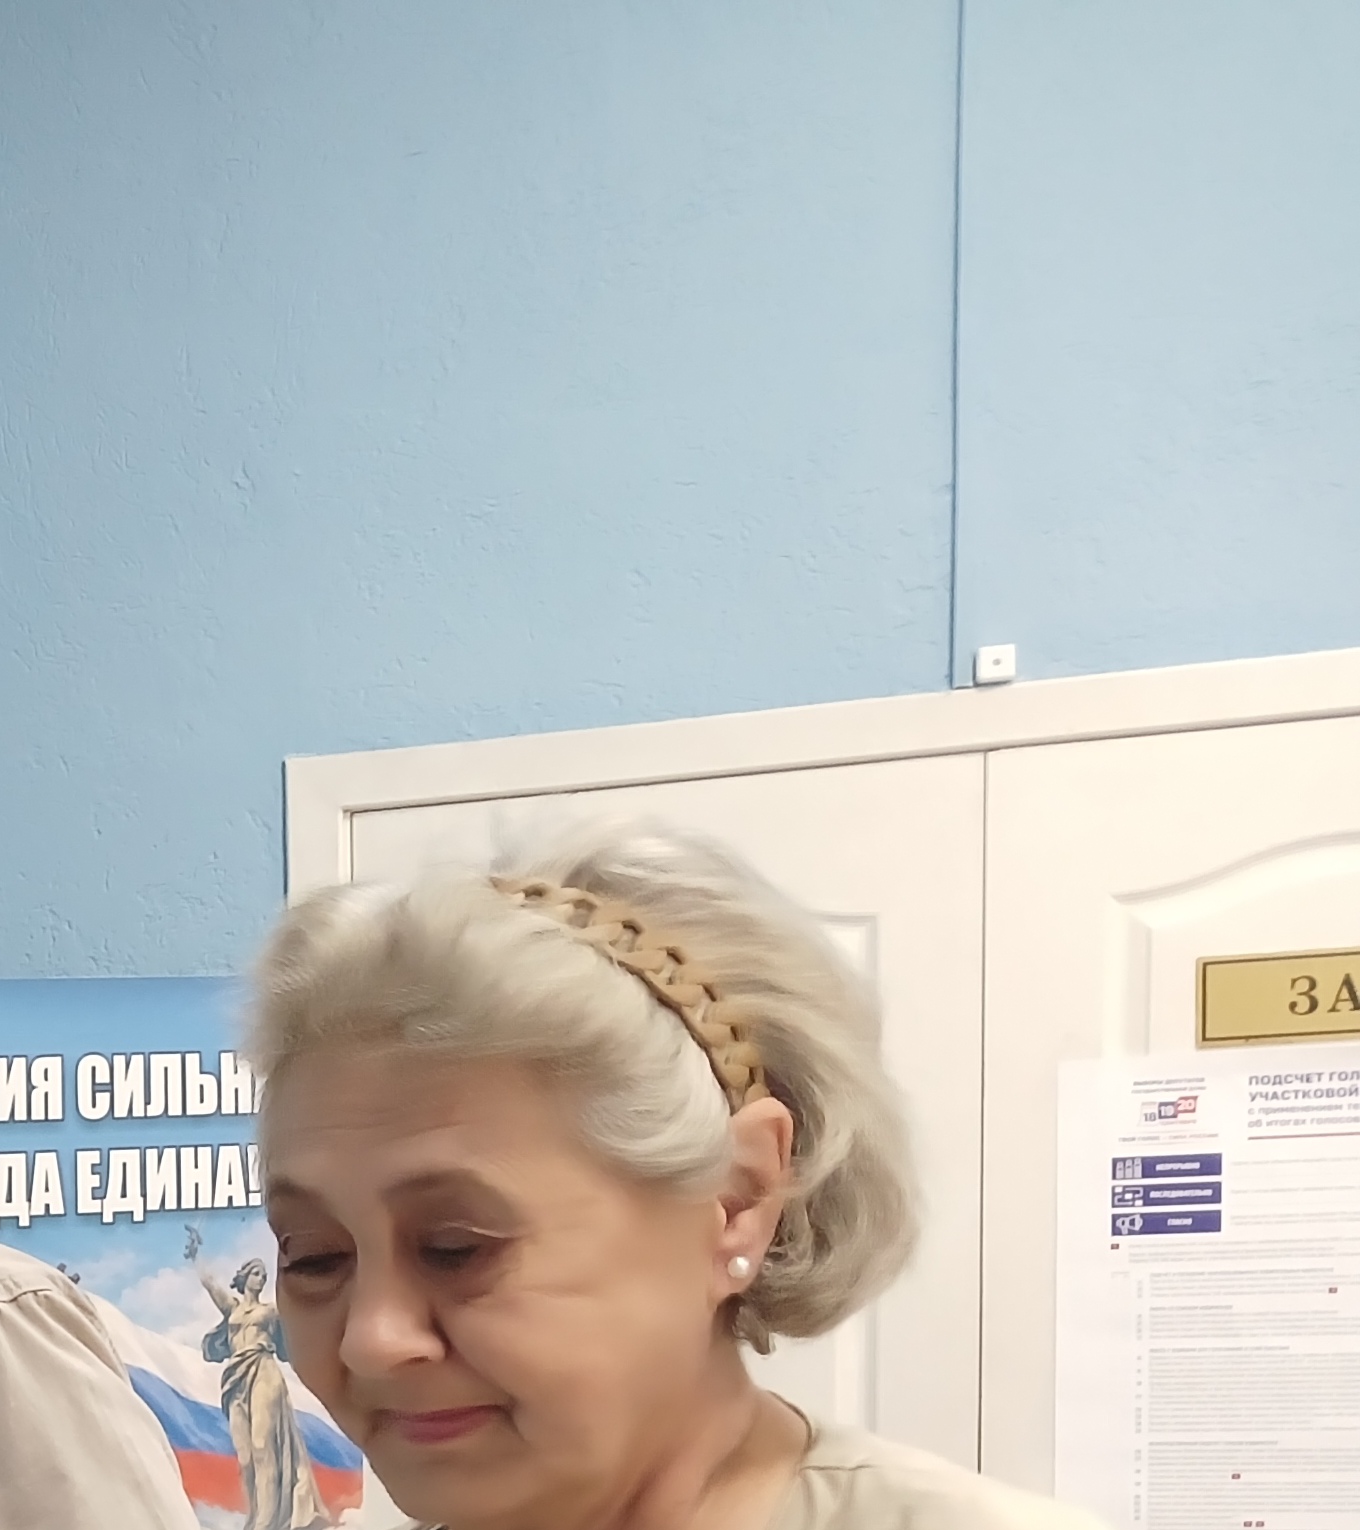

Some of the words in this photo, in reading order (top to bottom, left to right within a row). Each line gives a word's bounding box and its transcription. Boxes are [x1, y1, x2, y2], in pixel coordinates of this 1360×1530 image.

[76, 1050, 268, 1123] СИЛЬН
[1248, 1072, 1324, 1087] ПОДСЧЕТ
[1248, 1084, 1360, 1103] УЧАСТКОВОЙ
[1176, 1098, 1196, 1112] 20
[75, 1142, 264, 1225] ЕДИНА!
